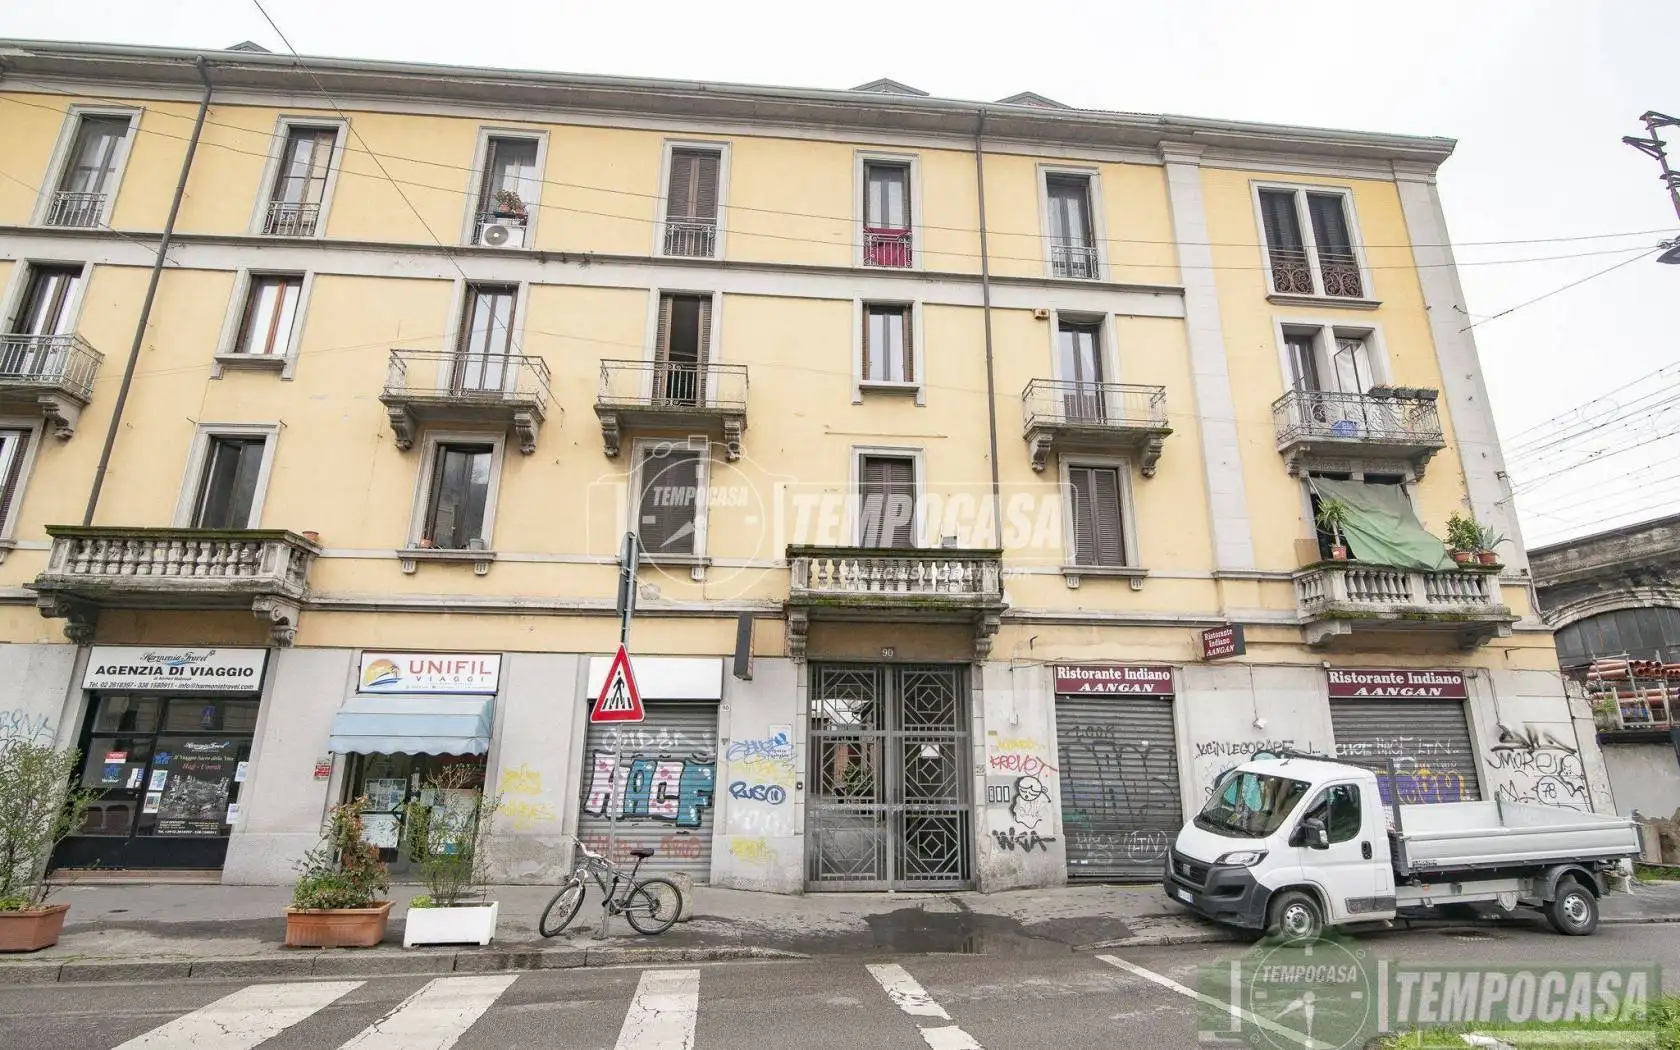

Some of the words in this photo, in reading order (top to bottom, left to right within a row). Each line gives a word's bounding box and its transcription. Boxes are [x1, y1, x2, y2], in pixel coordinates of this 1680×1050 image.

[1204, 629, 1233, 641] Ristorante
[1208, 637, 1230, 648] Indiano
[882, 648, 894, 657] 90
[1206, 643, 1235, 656] AANGAN
[95, 665, 163, 676] AGENZIA
[168, 666, 185, 676] DI
[190, 667, 254, 677] VIAGGIO
[409, 660, 492, 675] UNIFIL
[1057, 666, 1121, 680] Ristorante
[1124, 668, 1170, 681] Indiano
[1329, 671, 1404, 684] Ristorante
[1408, 672, 1461, 684] Indiano
[1079, 683, 1155, 692] AANGAN
[1354, 687, 1442, 696] AANGAN
